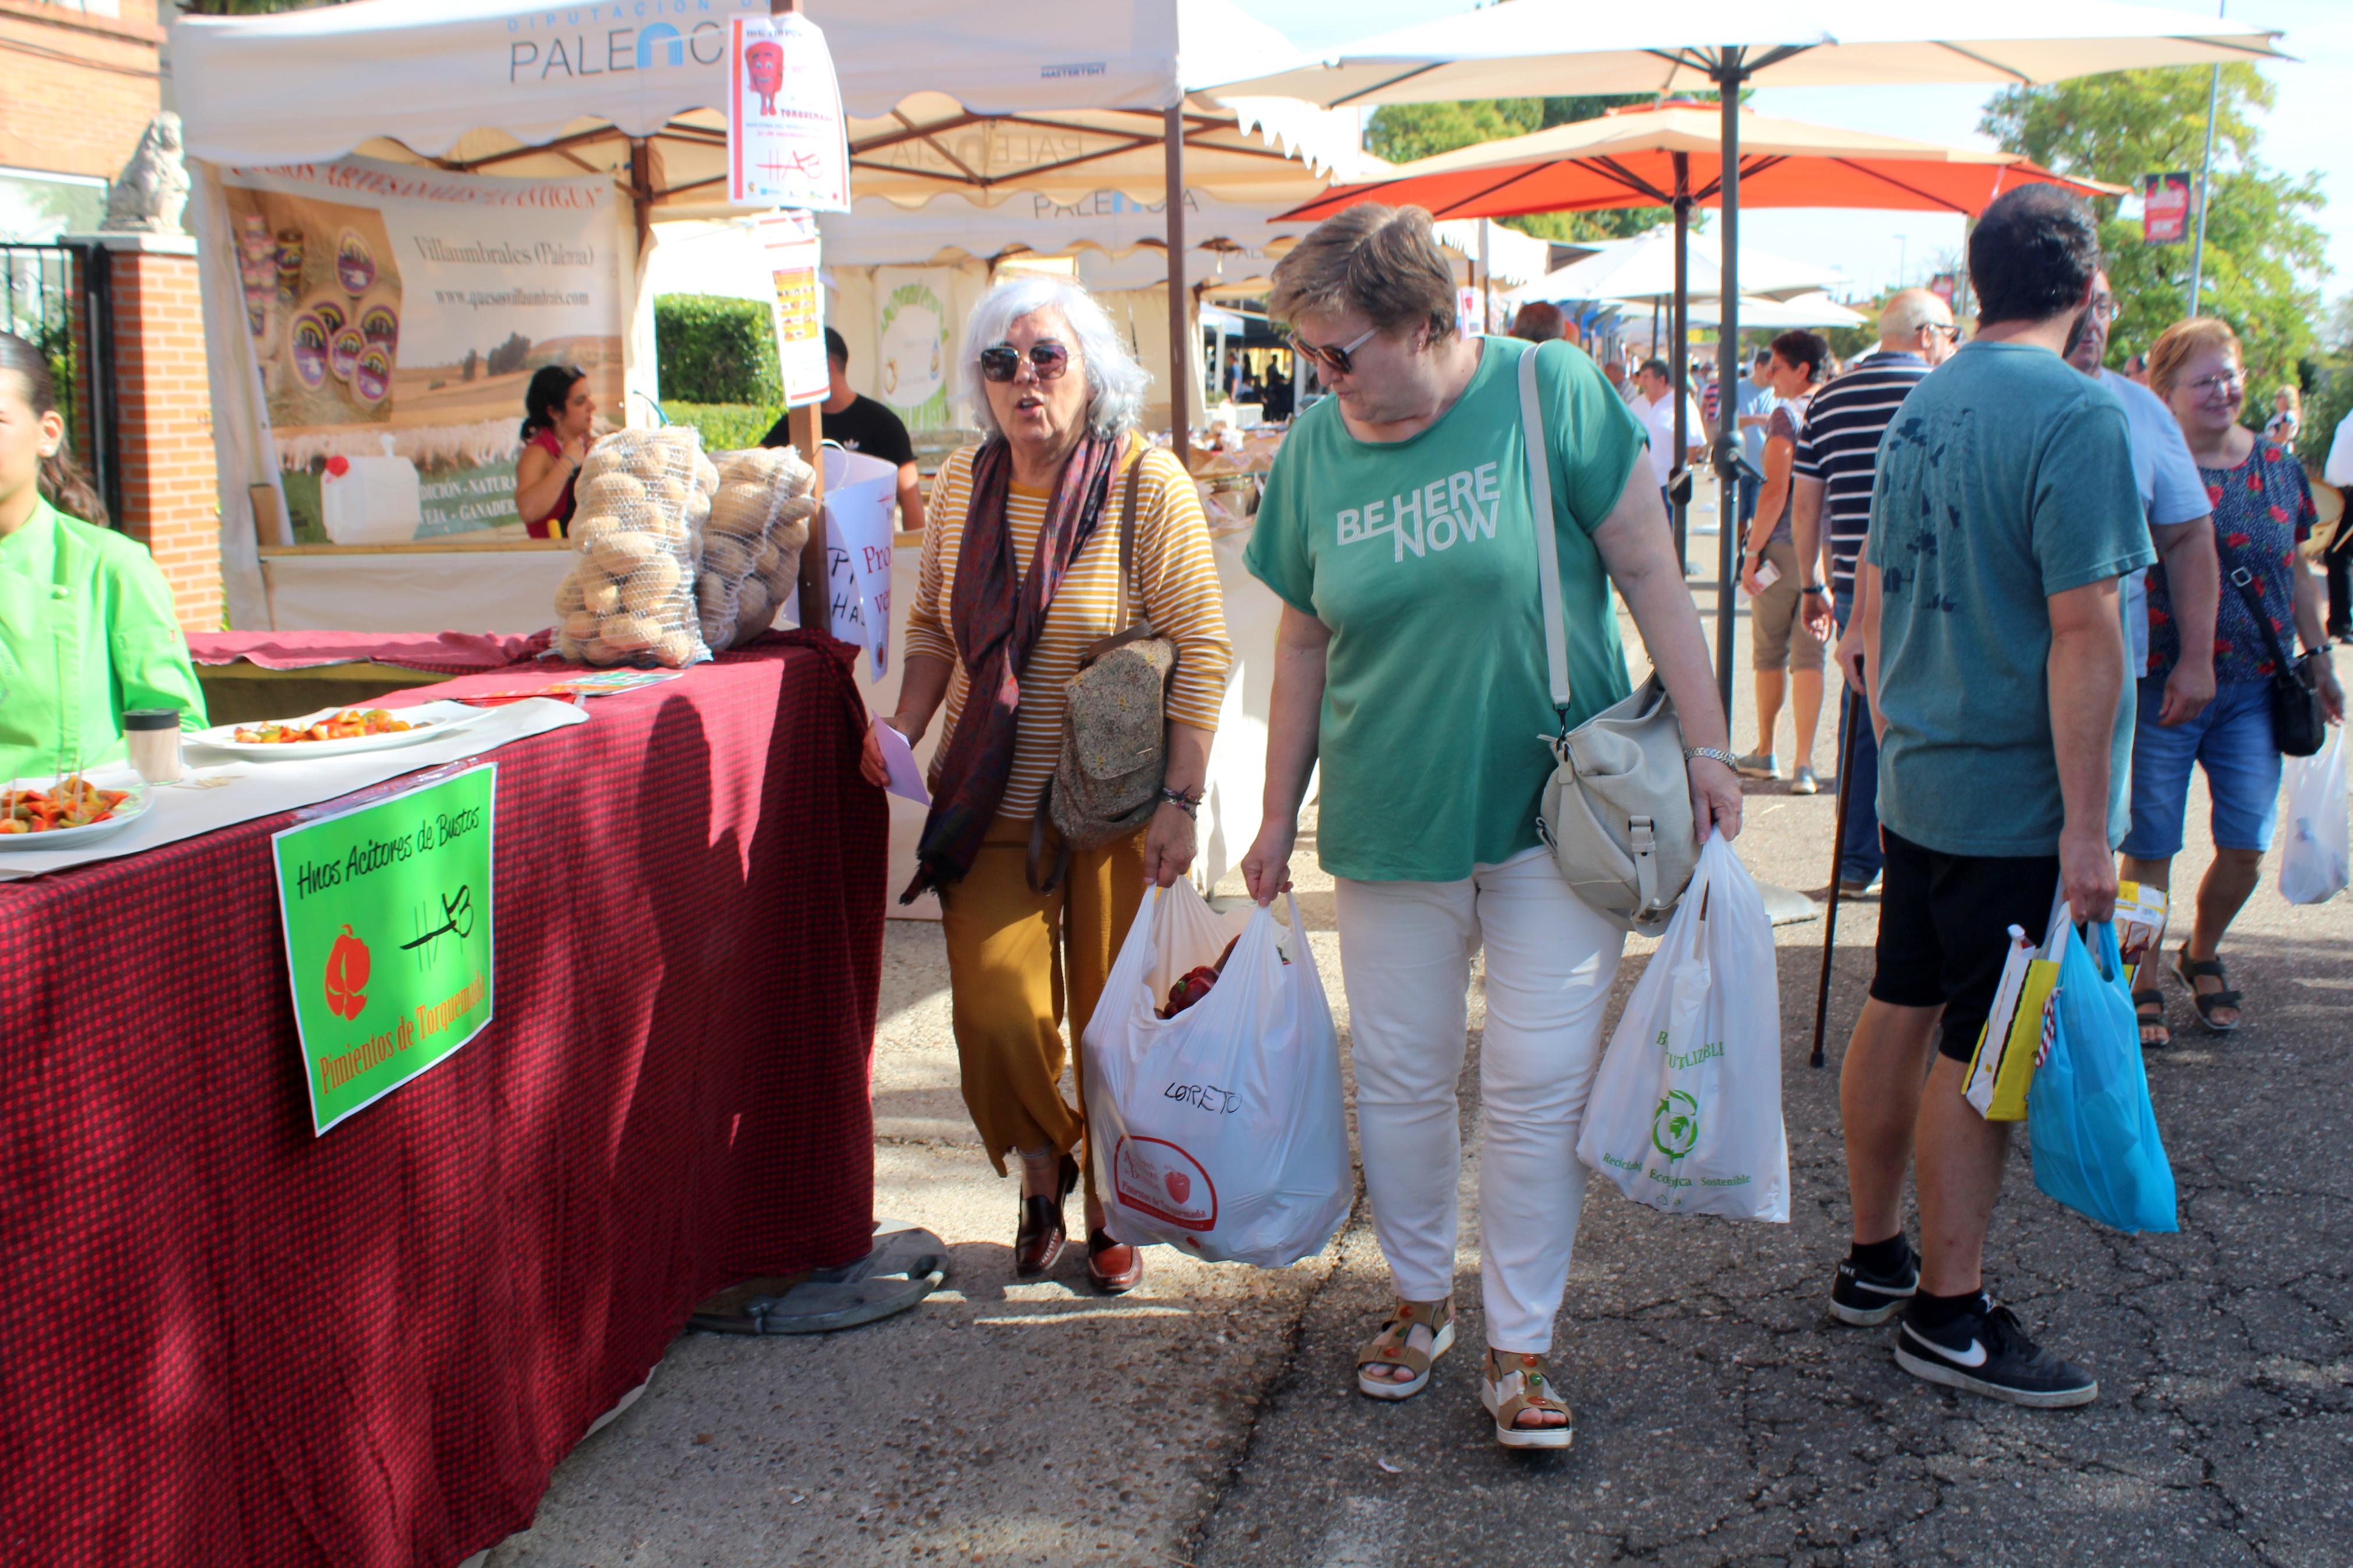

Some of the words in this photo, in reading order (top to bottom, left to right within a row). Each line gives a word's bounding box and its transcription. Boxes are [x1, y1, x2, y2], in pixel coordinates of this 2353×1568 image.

[1336, 499, 1394, 546] BE
[1393, 461, 1501, 531] HERE
[1393, 497, 1500, 563] NOW
[297, 859, 340, 900] Hnos
[346, 834, 412, 882] Acitores
[417, 819, 435, 852] de
[435, 806, 480, 847] Bustos
[318, 1031, 394, 1095] Pimientos
[396, 1016, 414, 1051] de
[415, 969, 485, 1040] Torquemada
[1164, 1082, 1243, 1114] LORETO
[1701, 1174, 1751, 1186] Sostenible
